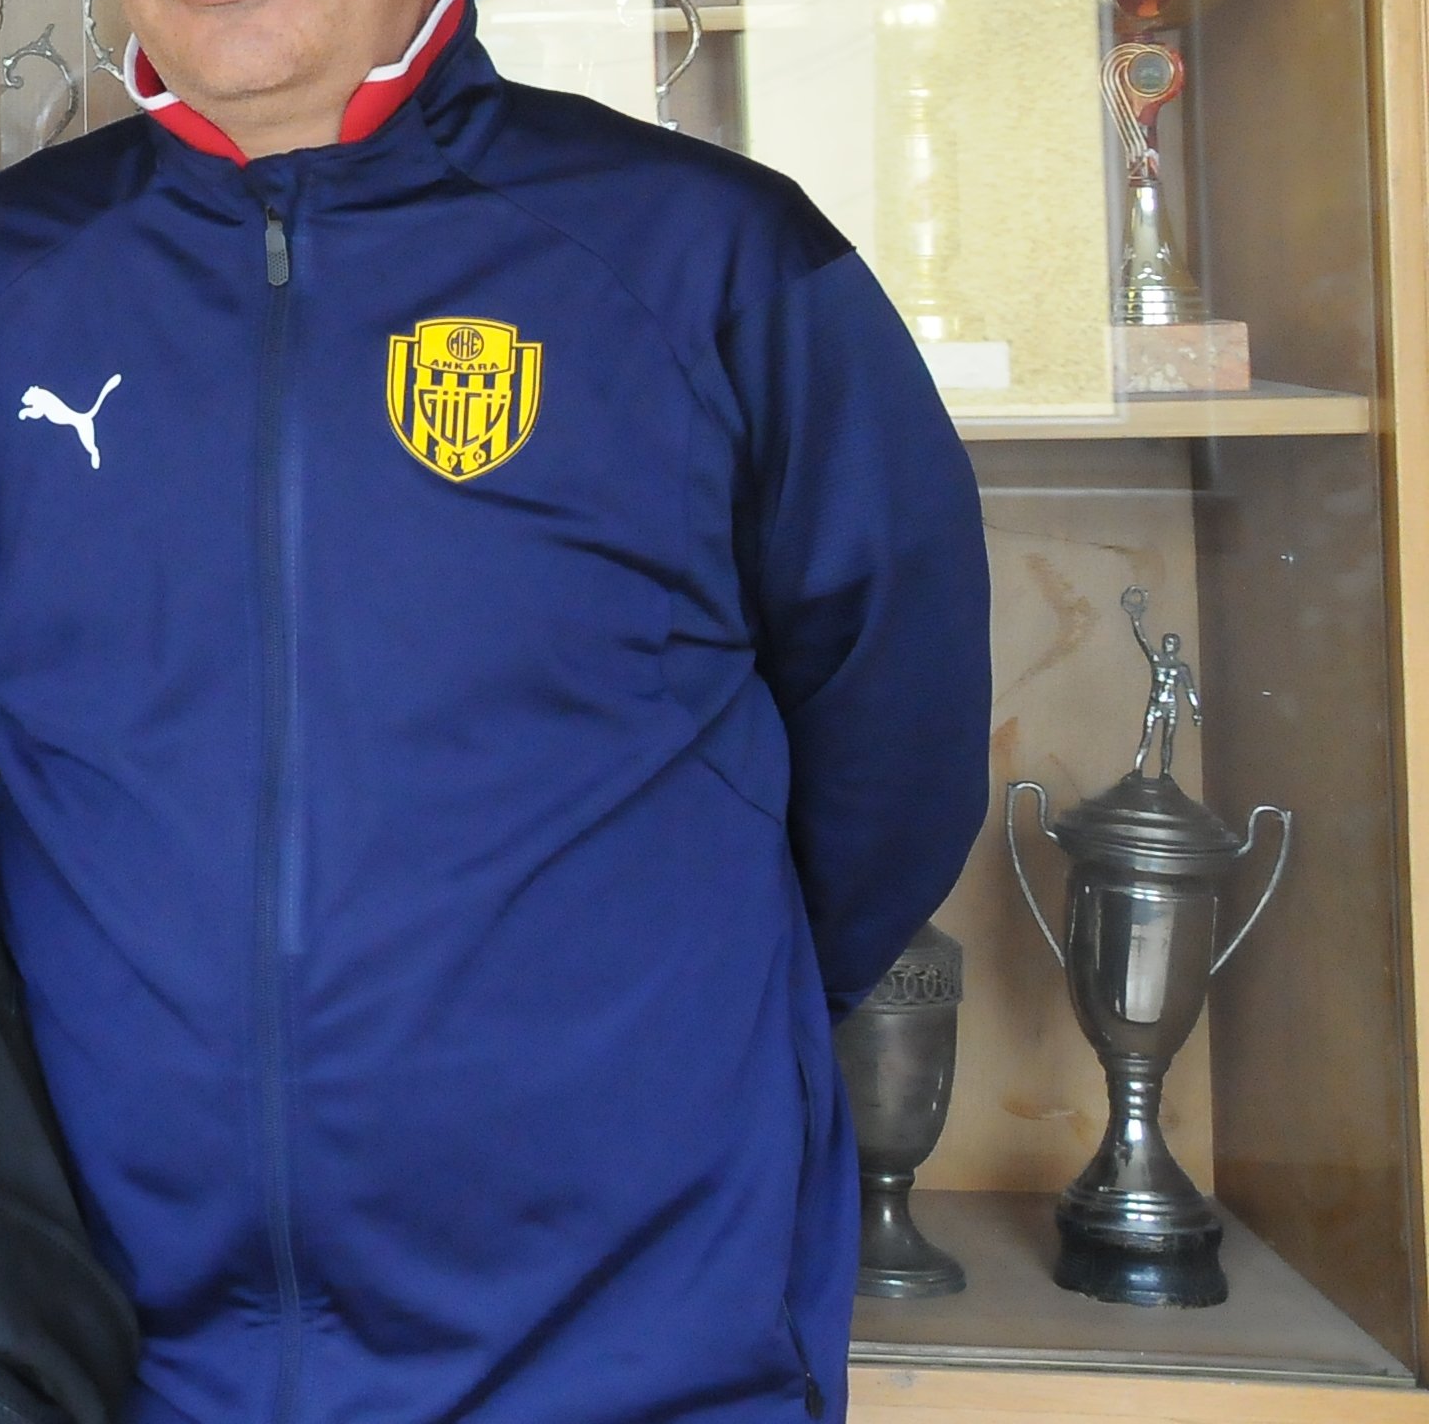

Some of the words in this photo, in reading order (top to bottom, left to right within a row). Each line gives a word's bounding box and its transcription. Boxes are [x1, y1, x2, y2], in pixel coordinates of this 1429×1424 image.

[450, 330, 481, 358] MKE
[429, 359, 500, 371] ANKARA
[419, 390, 507, 447] GÜCÜ
